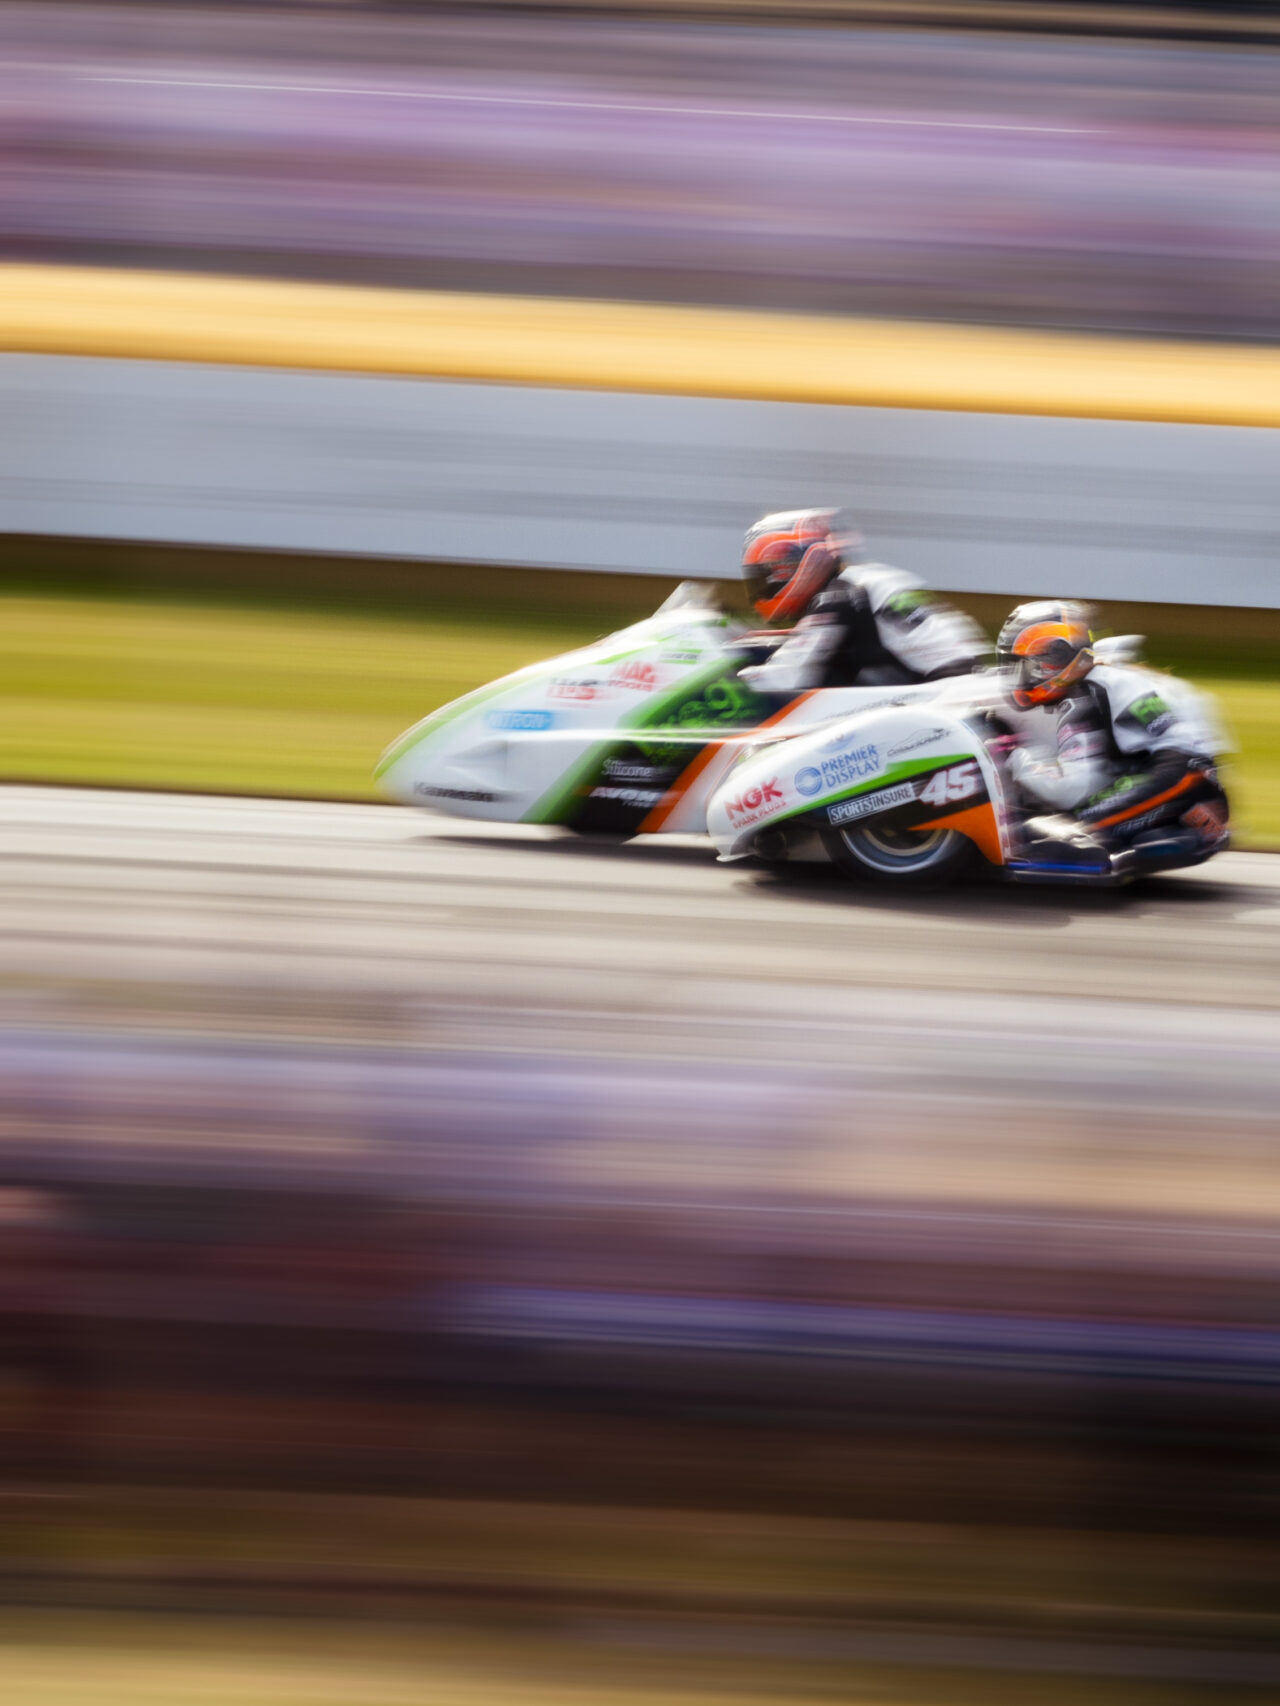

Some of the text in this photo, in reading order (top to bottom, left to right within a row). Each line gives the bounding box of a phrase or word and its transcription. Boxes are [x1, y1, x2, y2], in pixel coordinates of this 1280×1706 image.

[821, 744, 878, 774] PREMIER
[825, 758, 880, 788] DISPLAY
[724, 776, 783, 820] NGK
[919, 761, 978, 807] 45
